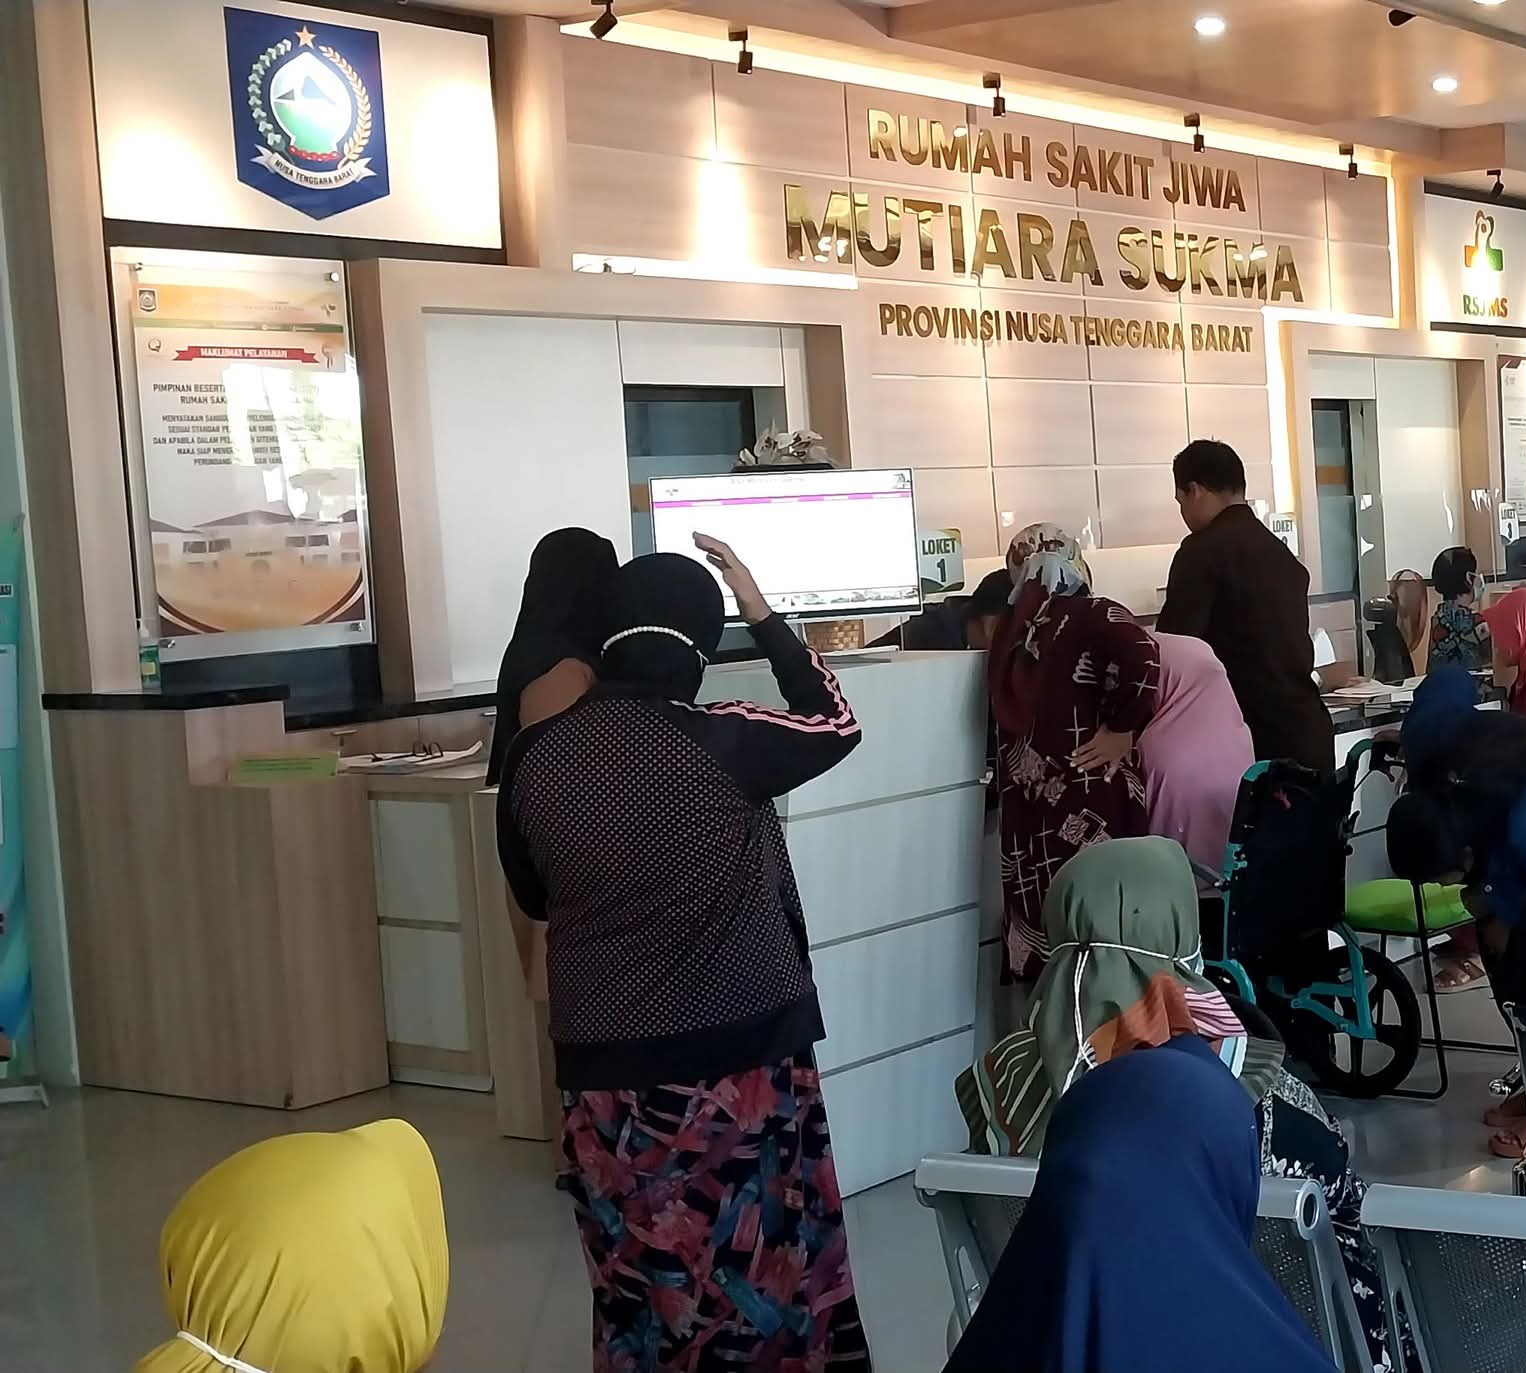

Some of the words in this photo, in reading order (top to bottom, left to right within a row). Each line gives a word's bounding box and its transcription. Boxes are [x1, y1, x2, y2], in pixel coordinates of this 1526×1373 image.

[274, 159, 294, 177] NUSA
[295, 172, 334, 185] TENGGARA
[866, 108, 1032, 182] RUMAH
[1046, 140, 1155, 200] SAKIT
[1162, 158, 1247, 212] JIWA
[784, 183, 1104, 287] MUTIARA
[1117, 226, 1304, 303] SUKMA
[879, 303, 1001, 345] PROVINSI
[1005, 310, 1067, 345] NUSA
[1070, 315, 1185, 352] TENGGARA
[1190, 323, 1253, 353] BARAT
[153, 383, 192, 392] PIMPINAN
[180, 395, 208, 404] RUMAH
[1272, 519, 1293, 533] LOKET
[921, 537, 957, 556] LOKET
[936, 558, 947, 583] 1
